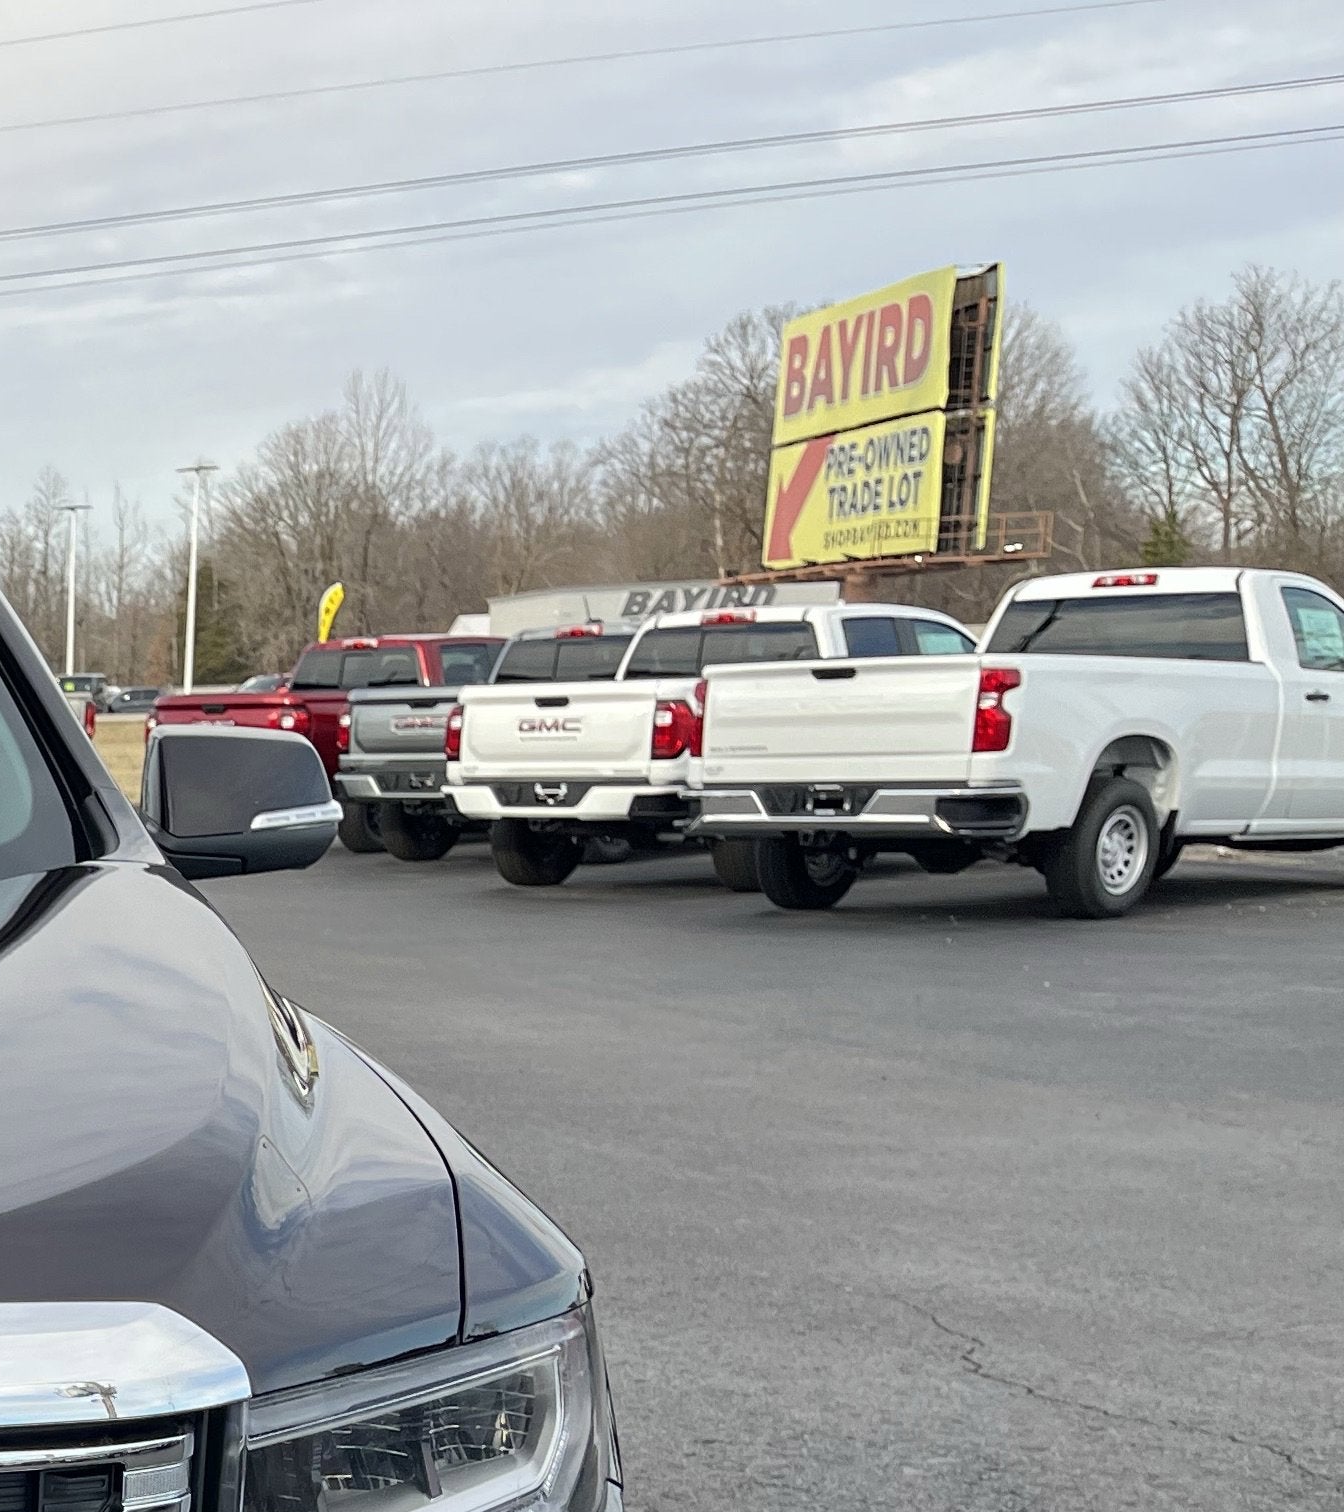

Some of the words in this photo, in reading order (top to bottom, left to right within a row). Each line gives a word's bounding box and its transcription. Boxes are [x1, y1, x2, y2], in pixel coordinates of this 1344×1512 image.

[783, 293, 934, 419] BAYIRD
[825, 427, 930, 480] PRE-OWNED
[828, 479, 883, 519] TRADE
[888, 471, 922, 512] LOT
[622, 585, 777, 616] BAYIRD
[518, 718, 582, 732] GMC
